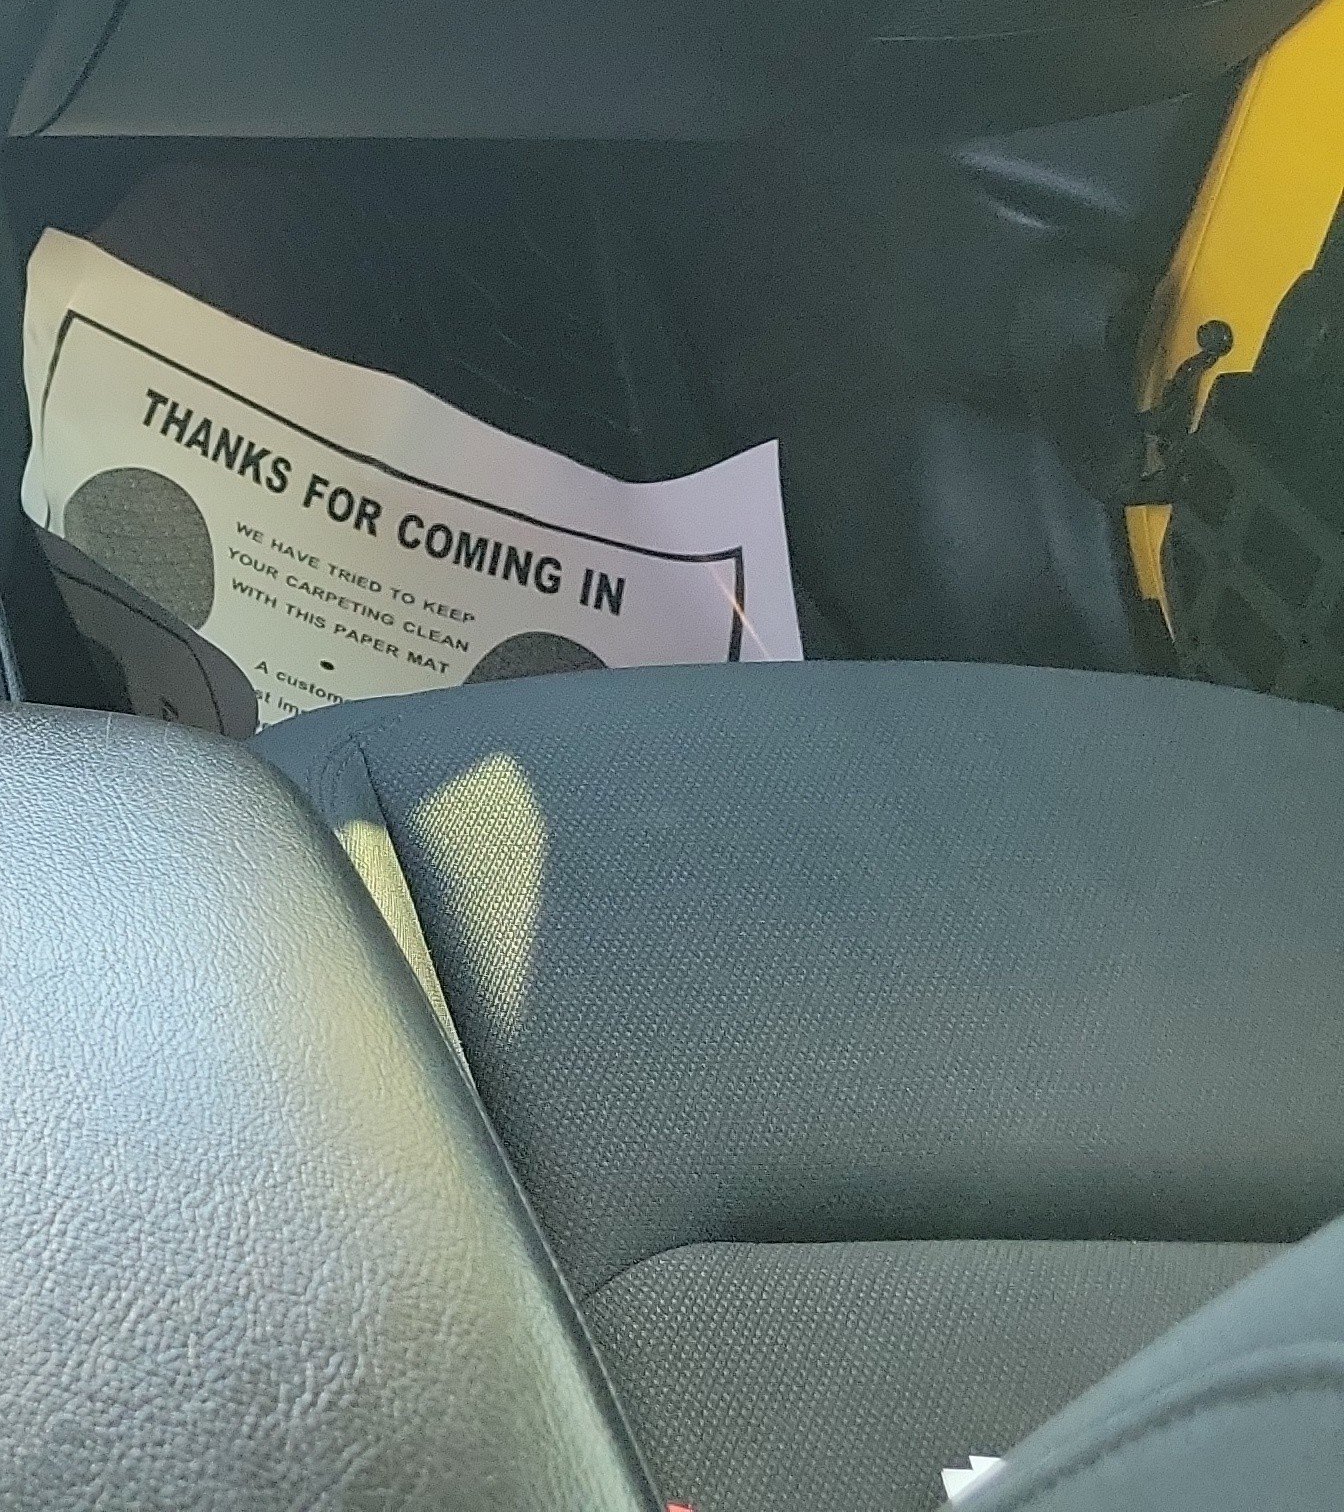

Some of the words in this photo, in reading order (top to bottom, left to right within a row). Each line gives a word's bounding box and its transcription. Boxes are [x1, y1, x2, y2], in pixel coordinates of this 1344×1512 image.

[141, 388, 293, 495] THANKS
[303, 472, 384, 536] FOR
[397, 514, 562, 595] COMING
[580, 568, 627, 616] IN
[228, 546, 279, 579] YOUR
[285, 574, 395, 626] CARPETING
[403, 620, 469, 652] CLEAN
[236, 521, 265, 544] WE
[271, 538, 320, 569] HAVE
[327, 563, 382, 593] TRIED
[391, 587, 416, 604] TO
[423, 599, 475, 623] KEEP
[231, 578, 278, 608] WITH
[285, 602, 326, 629] THIS
[333, 622, 399, 659] PAPER
[407, 649, 450, 674] MAT
[254, 660, 269, 674] A
